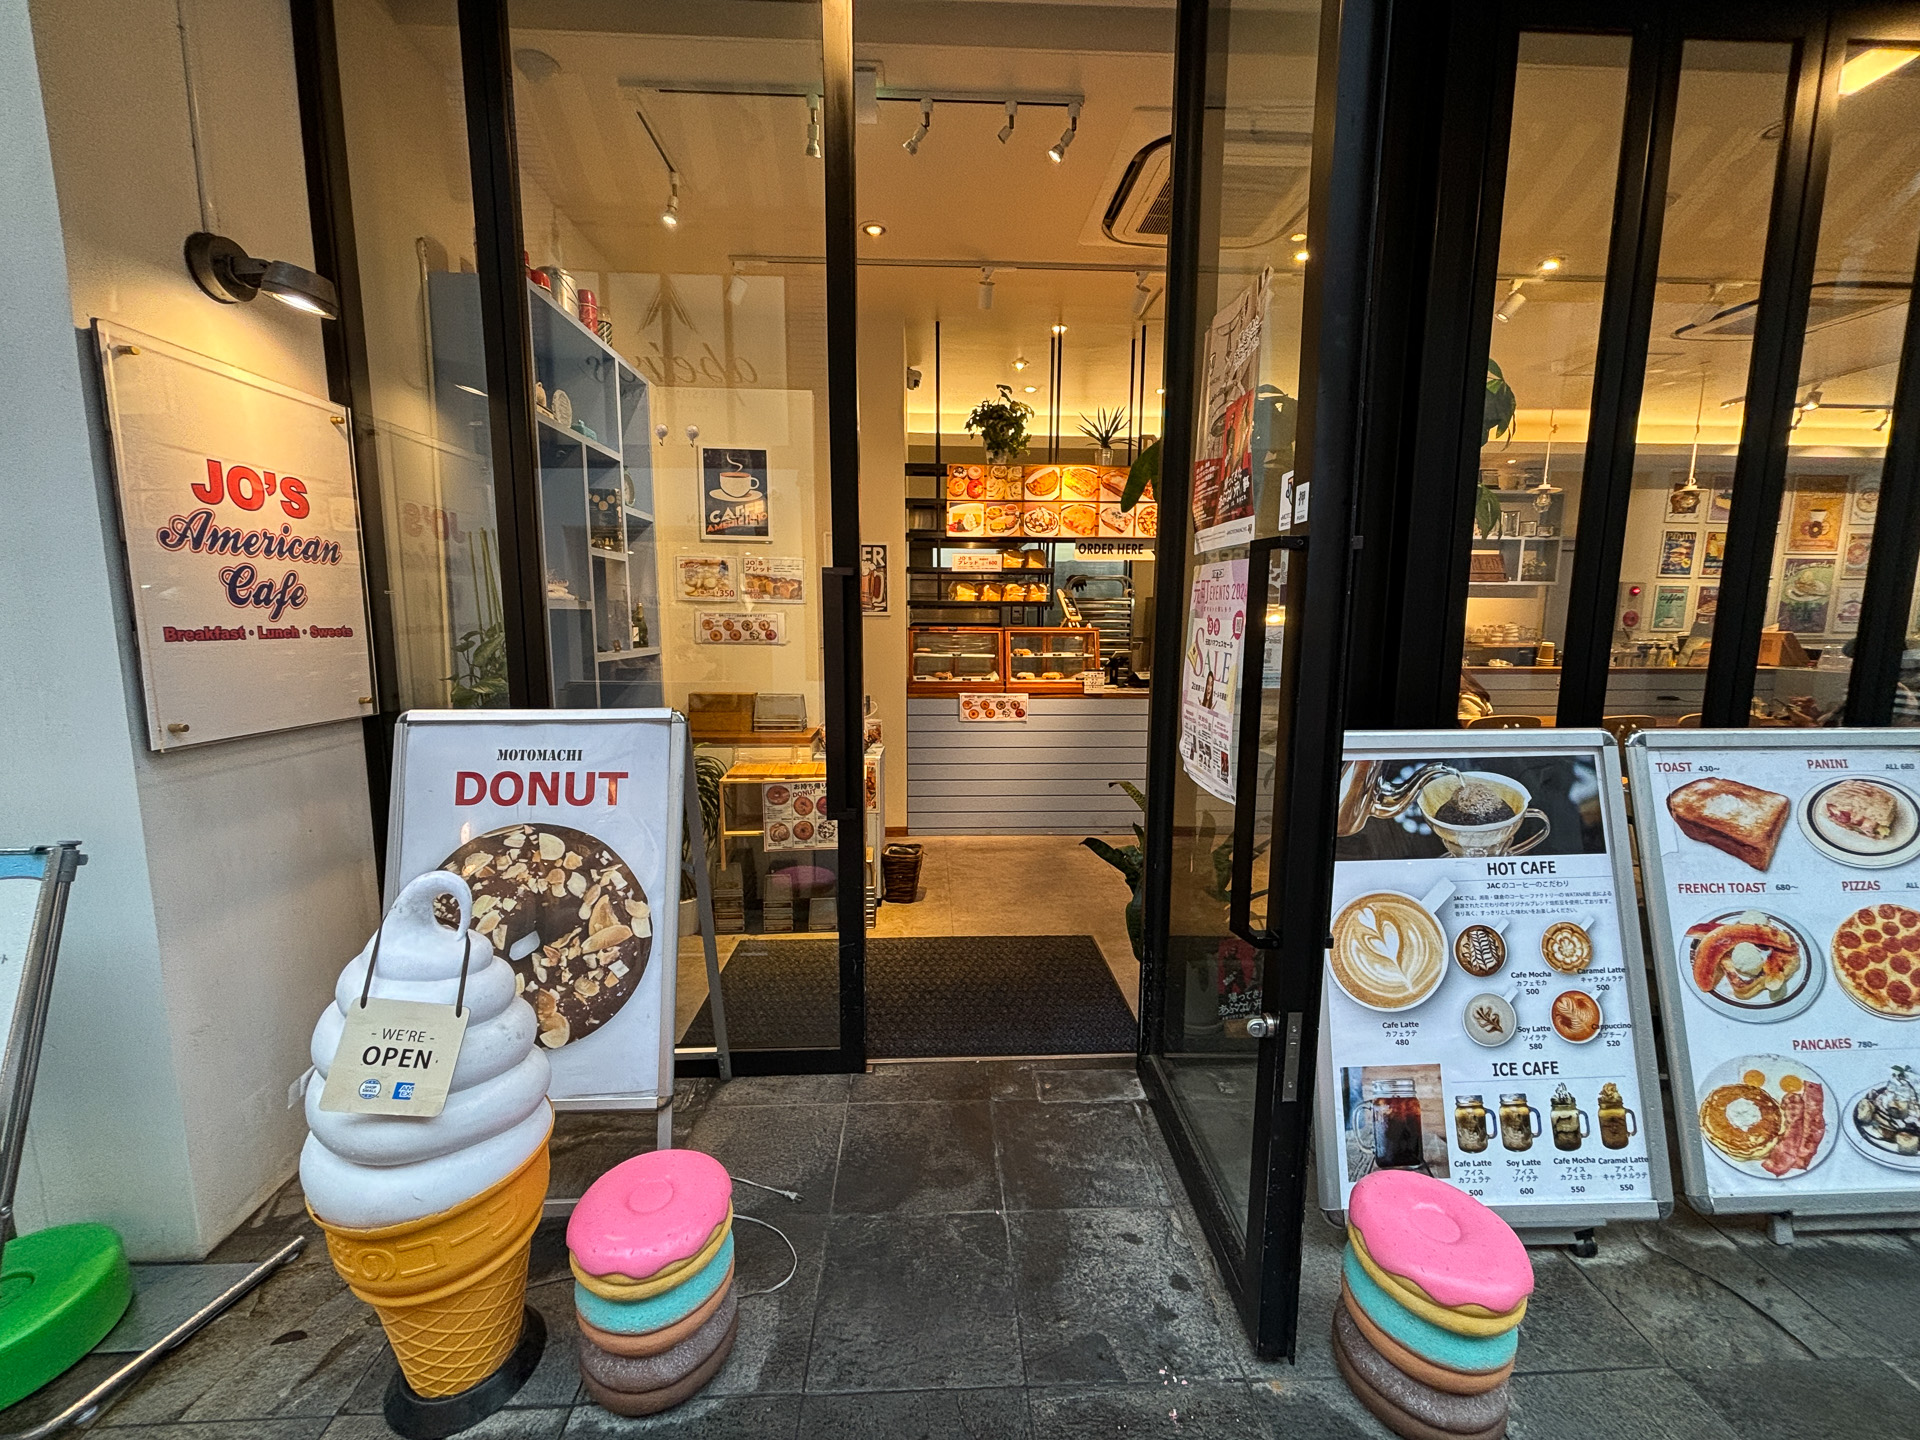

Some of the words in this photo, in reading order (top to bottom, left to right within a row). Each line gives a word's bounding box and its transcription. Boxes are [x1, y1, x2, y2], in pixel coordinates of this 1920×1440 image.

[190, 458, 311, 519] JO'S
[156, 508, 343, 567] American
[1078, 543, 1114, 554] ORDER
[1117, 543, 1144, 554] HERE
[861, 546, 886, 566] ER
[745, 565, 773, 573] ブレッド
[219, 563, 309, 621] Cafe
[163, 625, 247, 642] Breakfast
[257, 625, 300, 641] Lunch
[309, 624, 354, 639] Sweets
[496, 748, 584, 763] MOTOMACHI
[1655, 762, 1692, 773] TOAST
[1807, 759, 1849, 769] PANINI
[454, 771, 629, 807] DONUT
[792, 789, 816, 798] DONUT
[1487, 862, 1517, 876] HOT
[1520, 861, 1557, 874] CAFE
[1678, 883, 1725, 894] FRENCH
[1728, 882, 1766, 893] TOAST
[1842, 880, 1880, 891] PIZZAS
[1510, 971, 1526, 979] Cafe
[1577, 967, 1606, 976] Caramel
[1606, 966, 1626, 974] Latte
[1516, 979, 1547, 987] カフェモカ
[1580, 975, 1624, 983] キャラメルラテ
[1596, 984, 1610, 992] 500
[1382, 1021, 1399, 1029] Cafe
[1517, 1026, 1530, 1034] Soy
[1531, 1025, 1551, 1033] Latte
[1591, 1022, 1633, 1031] Cappuccino
[382, 1028, 427, 1043] WE'RE
[1385, 1030, 1418, 1038] カフェラテ
[1522, 1034, 1548, 1042] ソイラテ
[1792, 1038, 1852, 1051] PANCAKES
[362, 1046, 433, 1070] OPEN
[1492, 1062, 1518, 1077] ICE
[1522, 1061, 1559, 1076] CAFE
[1454, 1160, 1471, 1168] Cafe
[1506, 1160, 1520, 1168] Soy
[1513, 1175, 1539, 1183] ソイラテ
[1560, 1173, 1593, 1181] カフェモカ
[1603, 1172, 1648, 1180] キャラメルラテ
[1519, 1187, 1534, 1195] 600
[1619, 1184, 1634, 1192] 550
[1468, 1189, 1484, 1197] 500
